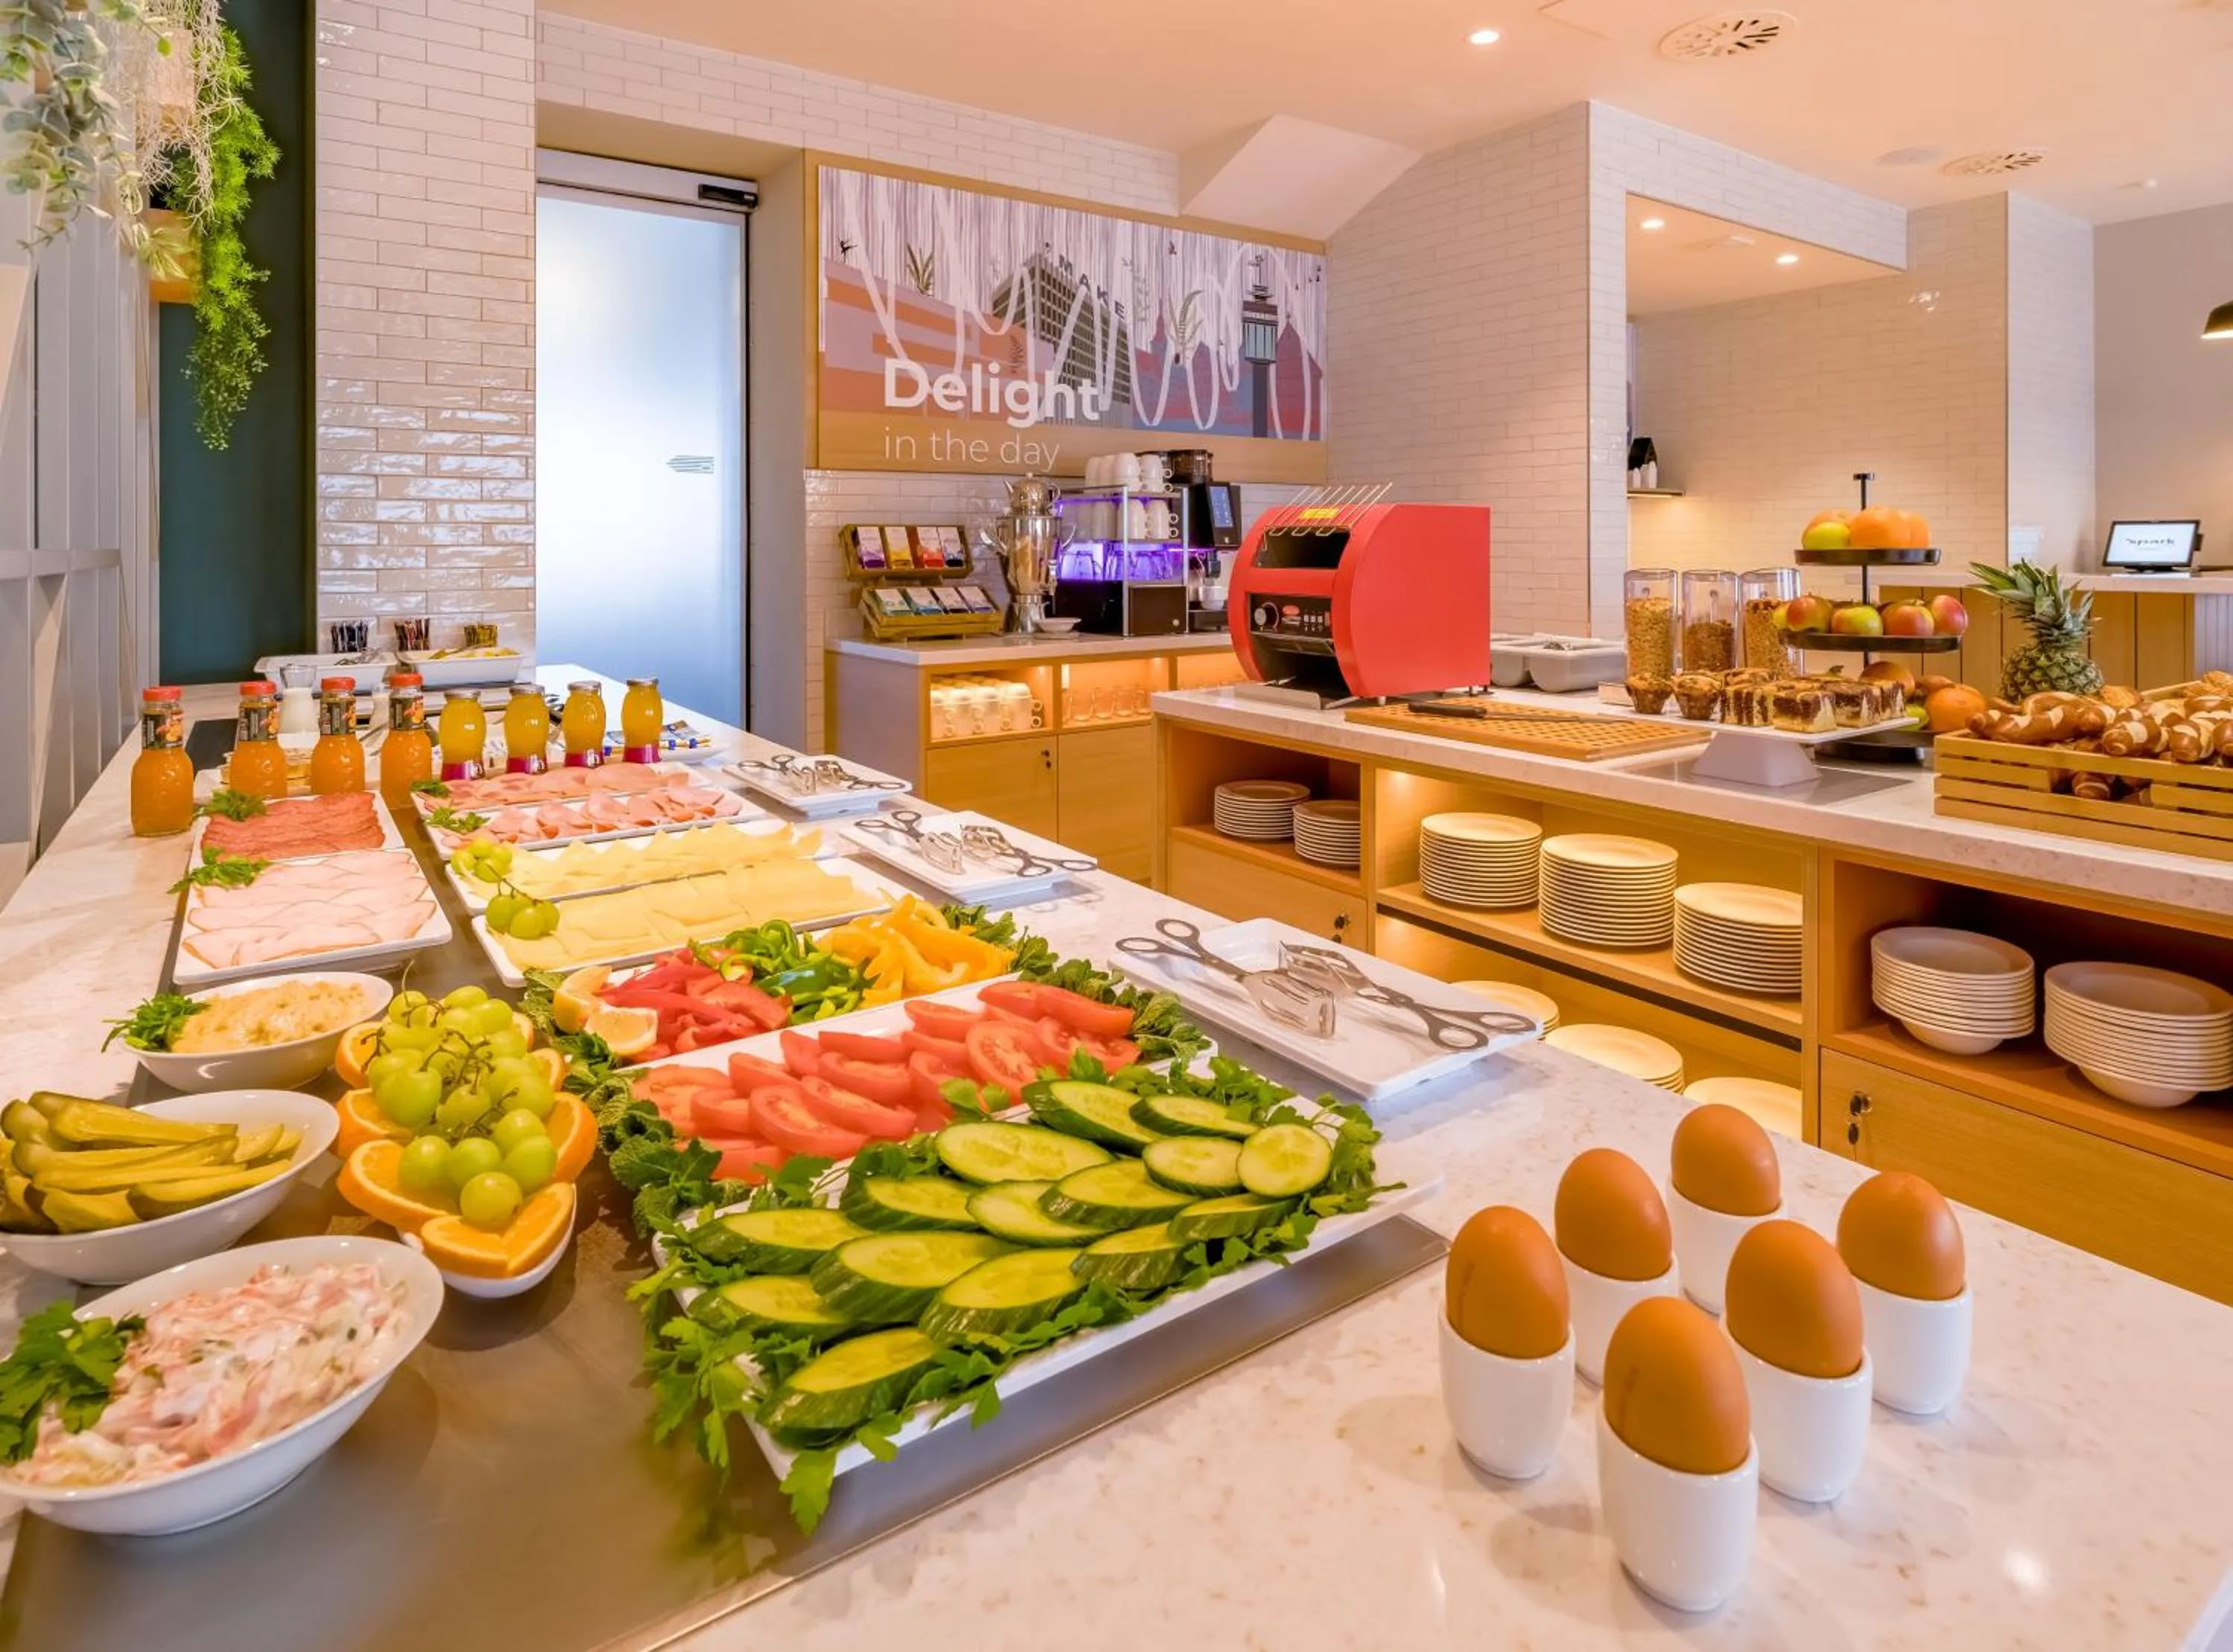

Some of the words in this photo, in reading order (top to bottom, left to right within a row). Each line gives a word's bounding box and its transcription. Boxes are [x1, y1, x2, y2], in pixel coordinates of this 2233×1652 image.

[1058, 254, 1125, 320] MAKE
[884, 358, 1100, 429] Delight
[883, 426, 917, 461] in
[929, 429, 989, 463] the
[1000, 433, 1061, 473] day
